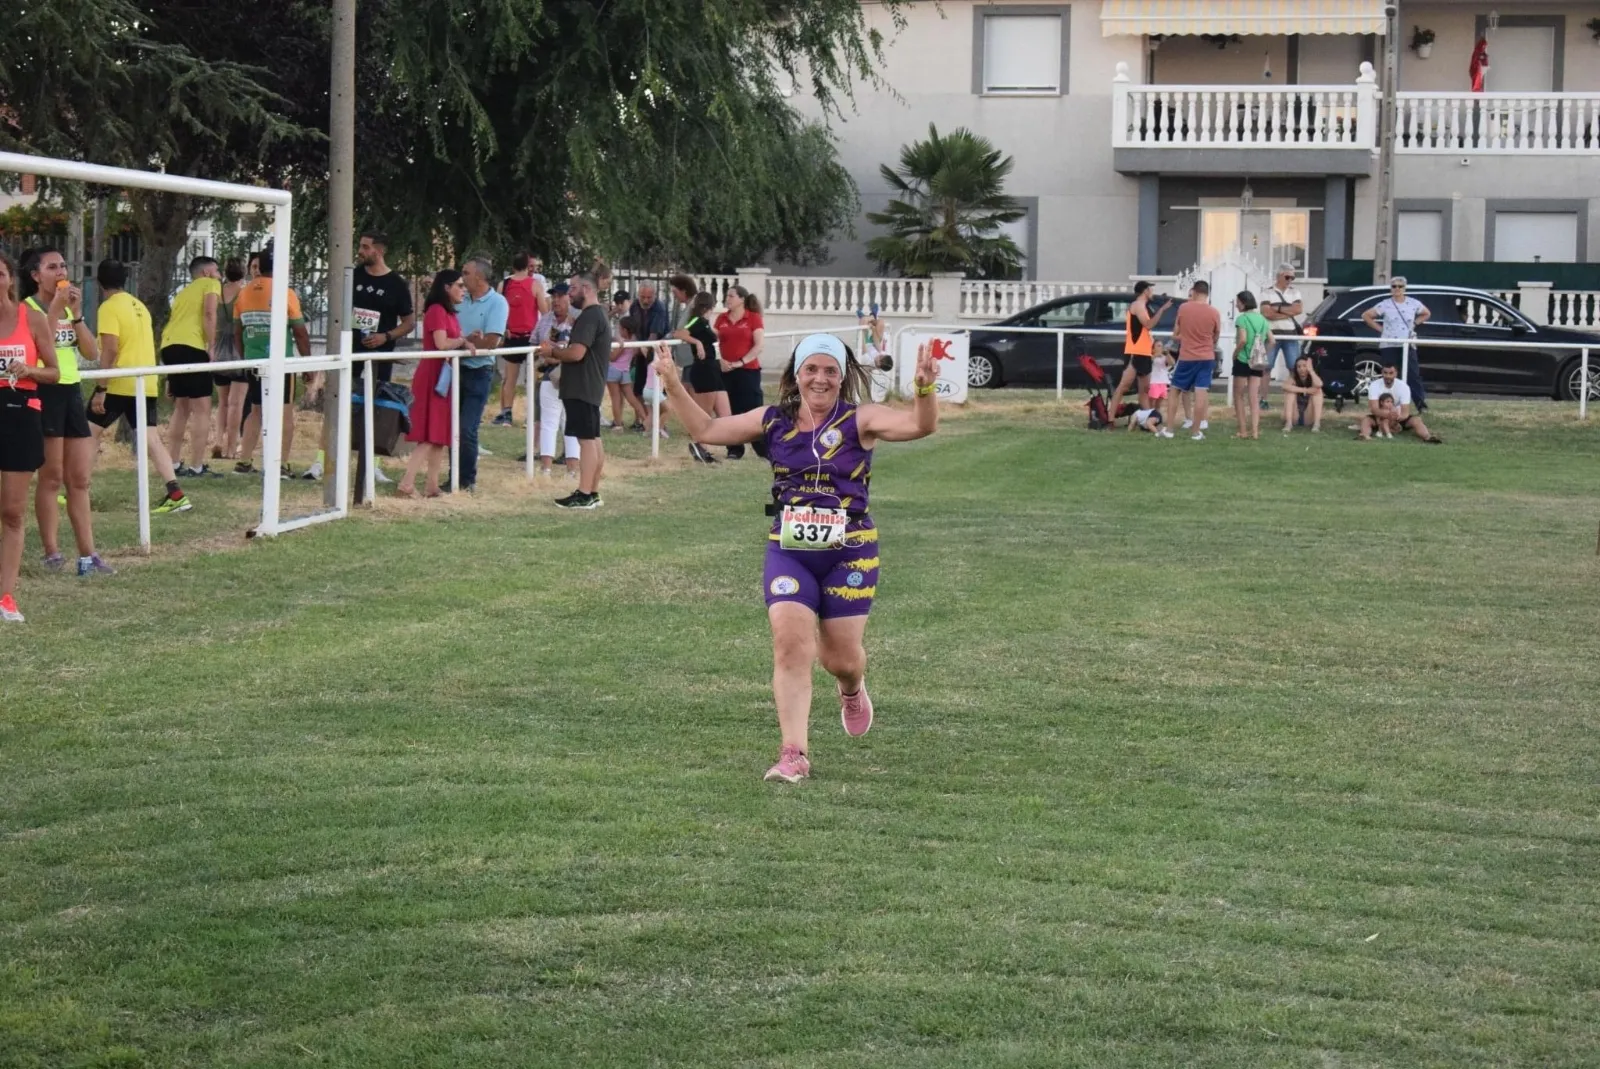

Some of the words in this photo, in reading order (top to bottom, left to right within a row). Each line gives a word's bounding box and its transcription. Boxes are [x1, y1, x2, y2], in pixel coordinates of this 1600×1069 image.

[356, 316, 373, 325] 248
[55, 330, 74, 342] 295
[793, 524, 833, 542] 337
